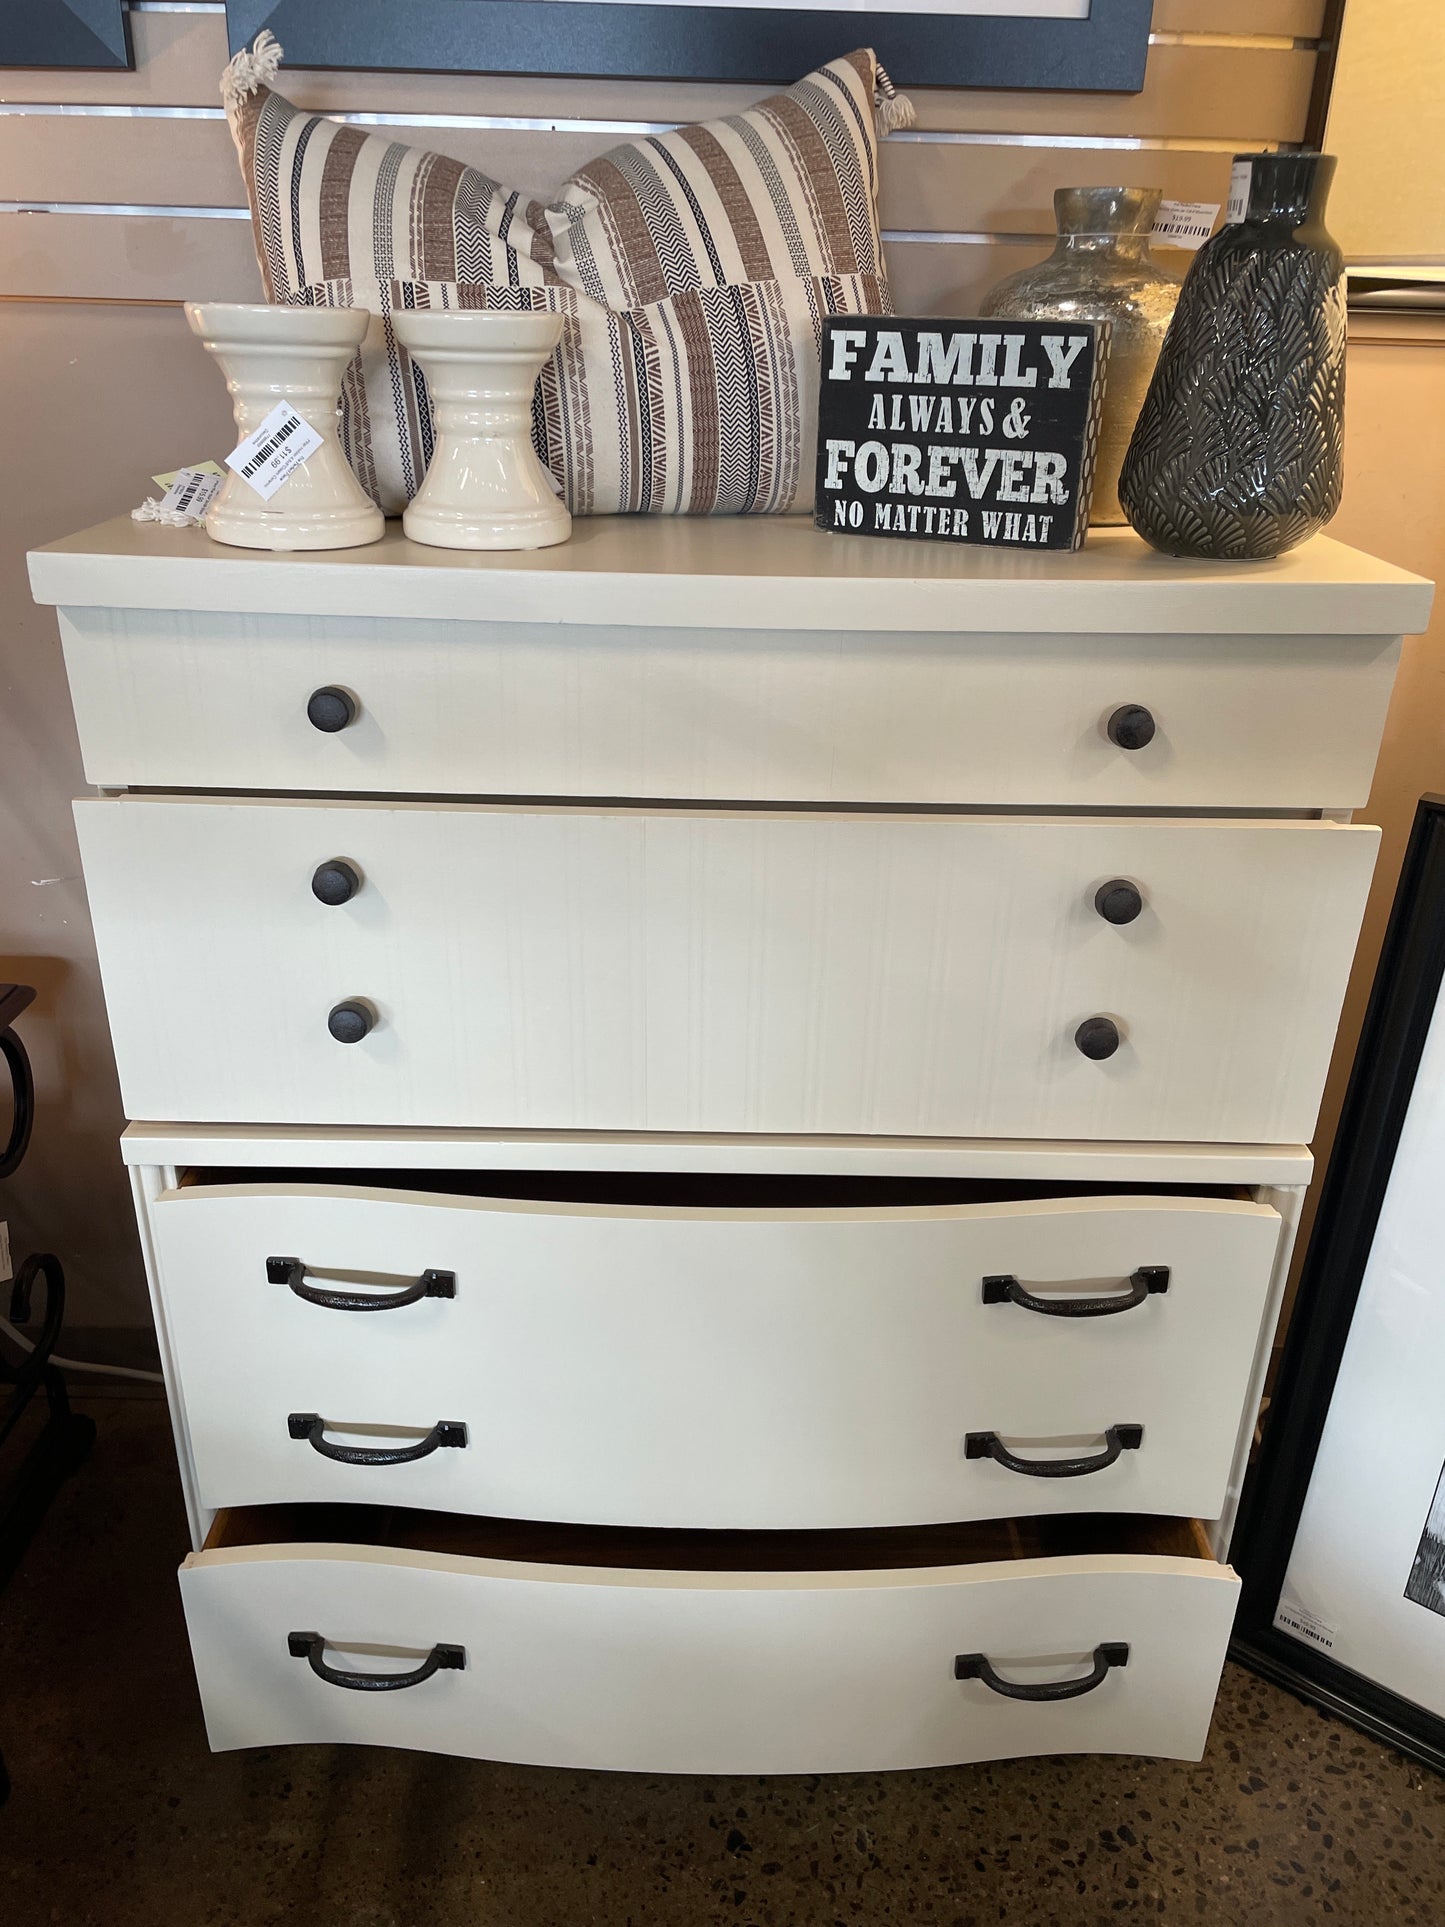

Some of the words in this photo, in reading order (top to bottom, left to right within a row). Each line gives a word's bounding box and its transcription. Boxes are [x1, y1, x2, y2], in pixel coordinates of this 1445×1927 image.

[828, 330, 1088, 389] FAMILY
[868, 394, 995, 436] ALWAYS
[1002, 397, 1031, 439] &
[270, 446, 292, 468] $11.99
[824, 439, 1070, 505] FOREVER
[833, 499, 864, 528] NO
[874, 503, 970, 537] MATTER
[981, 510, 1054, 543] WHAT
